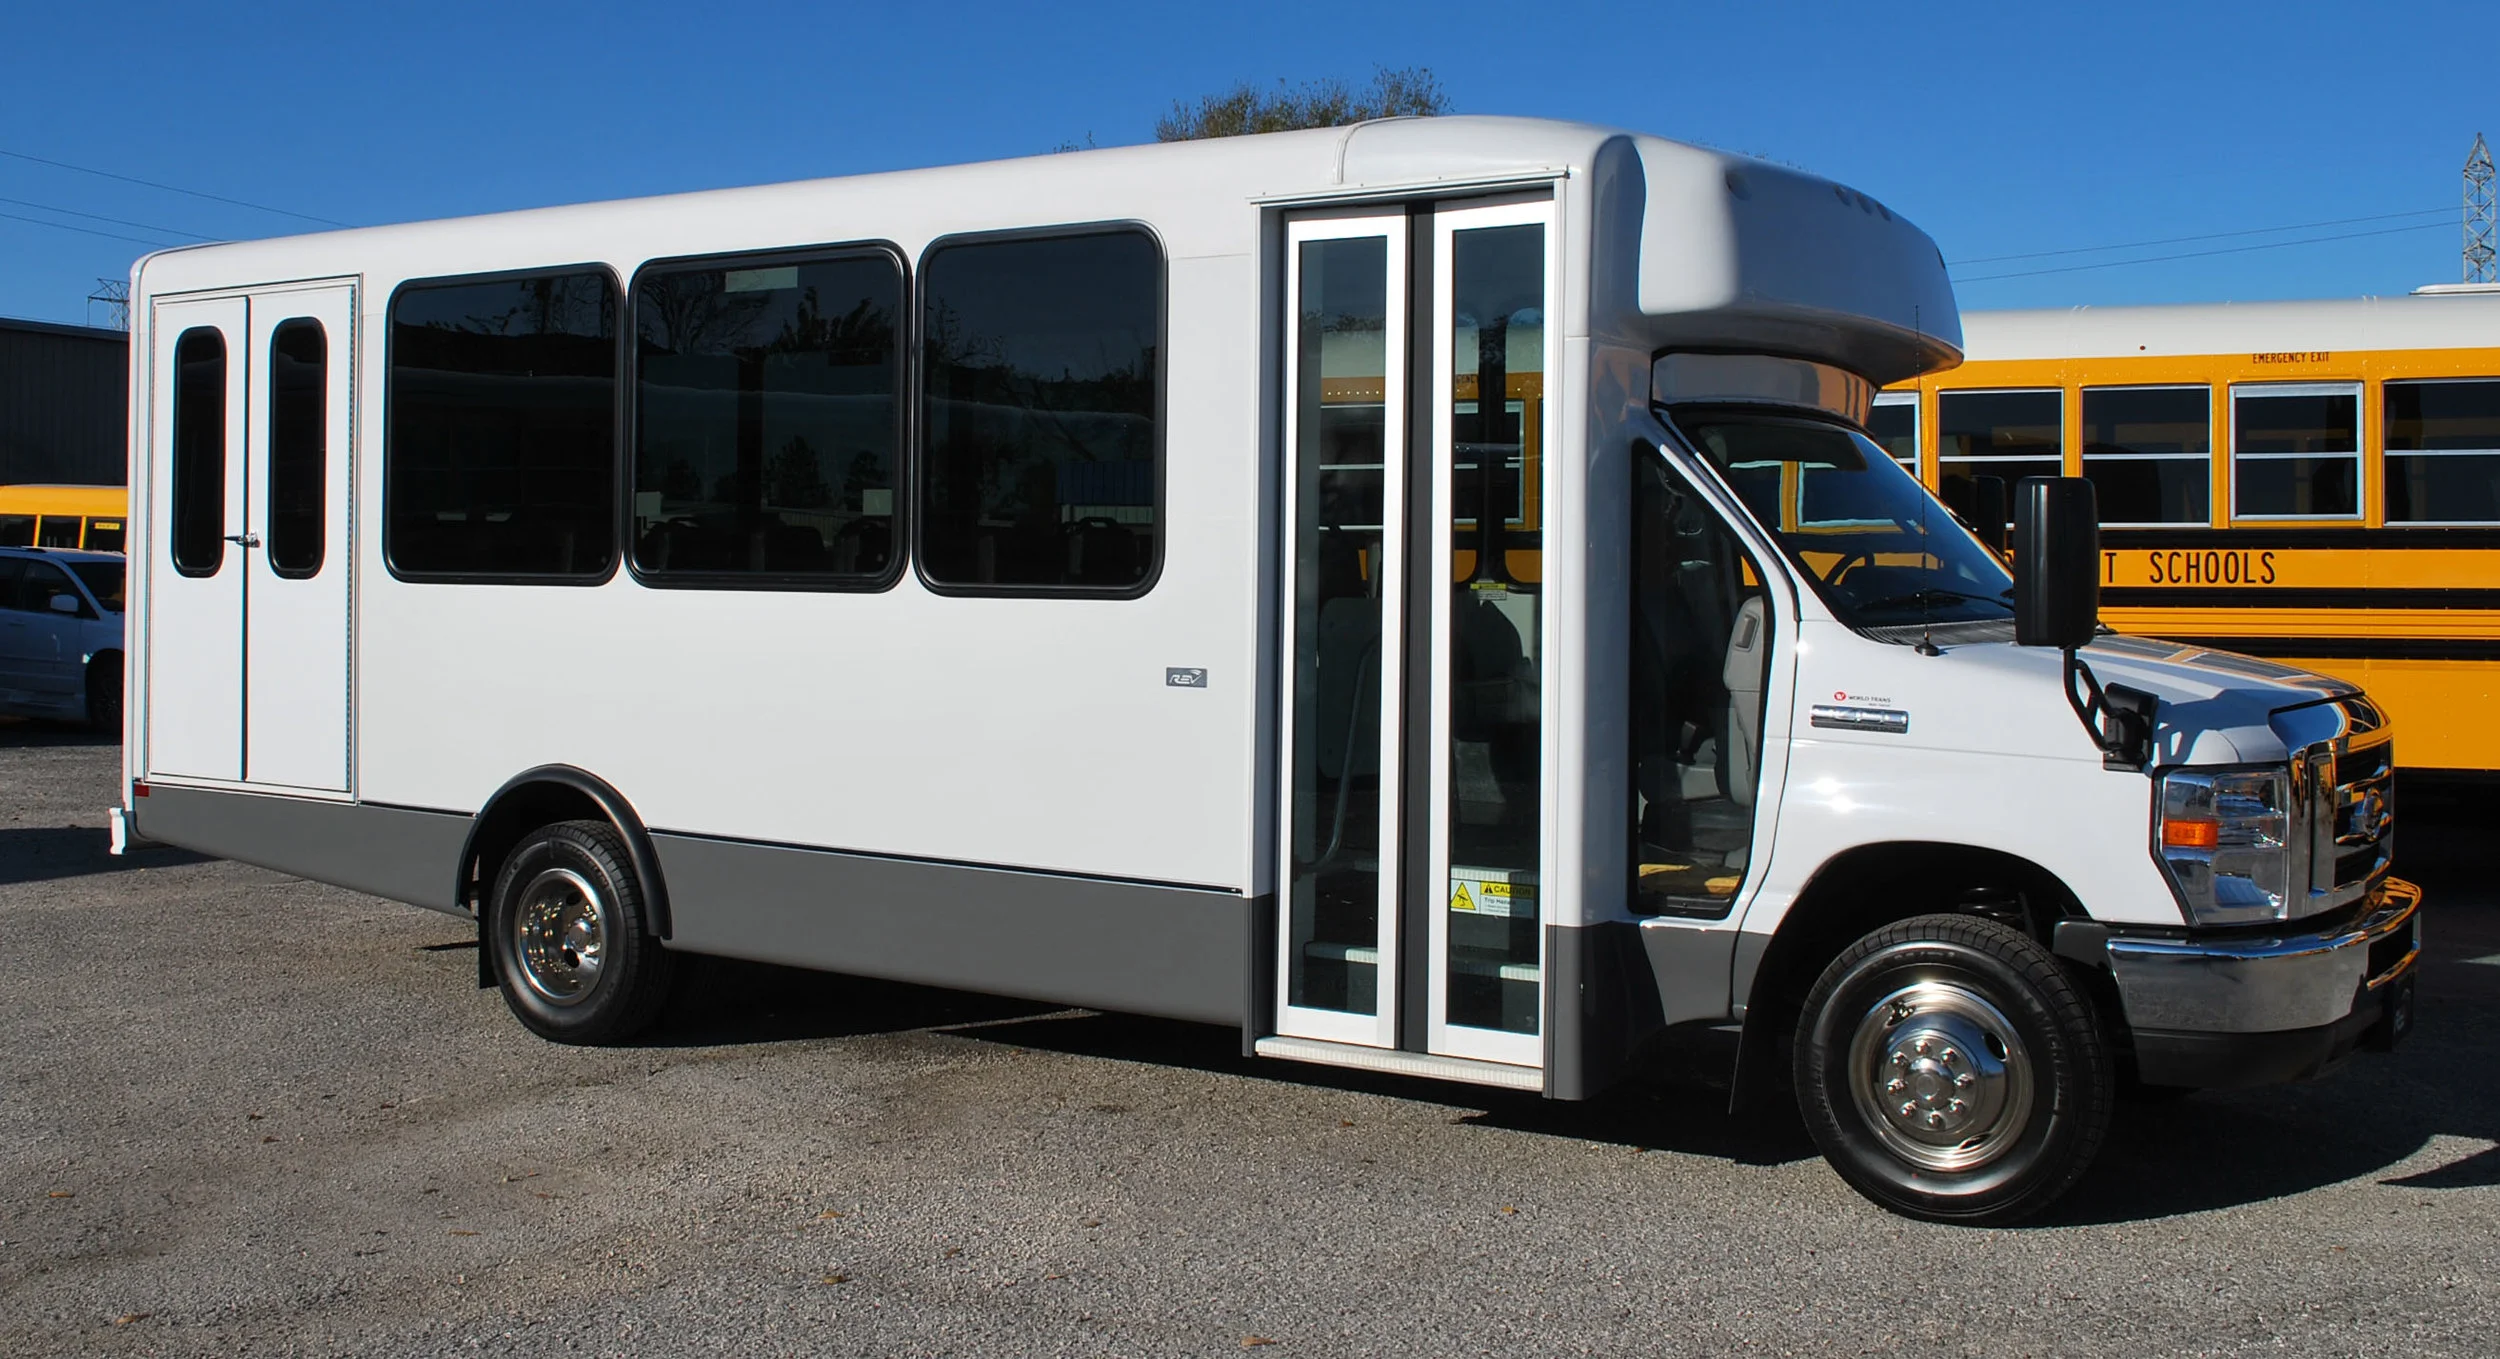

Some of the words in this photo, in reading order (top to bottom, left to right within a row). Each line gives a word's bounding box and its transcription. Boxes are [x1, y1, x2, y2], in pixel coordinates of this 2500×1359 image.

[2252, 352, 2306, 365] EMERGENCY
[2310, 351, 2330, 363] EXIT
[2149, 551, 2276, 584] SCHOOLS
[1493, 885, 1532, 897] CAUTION
